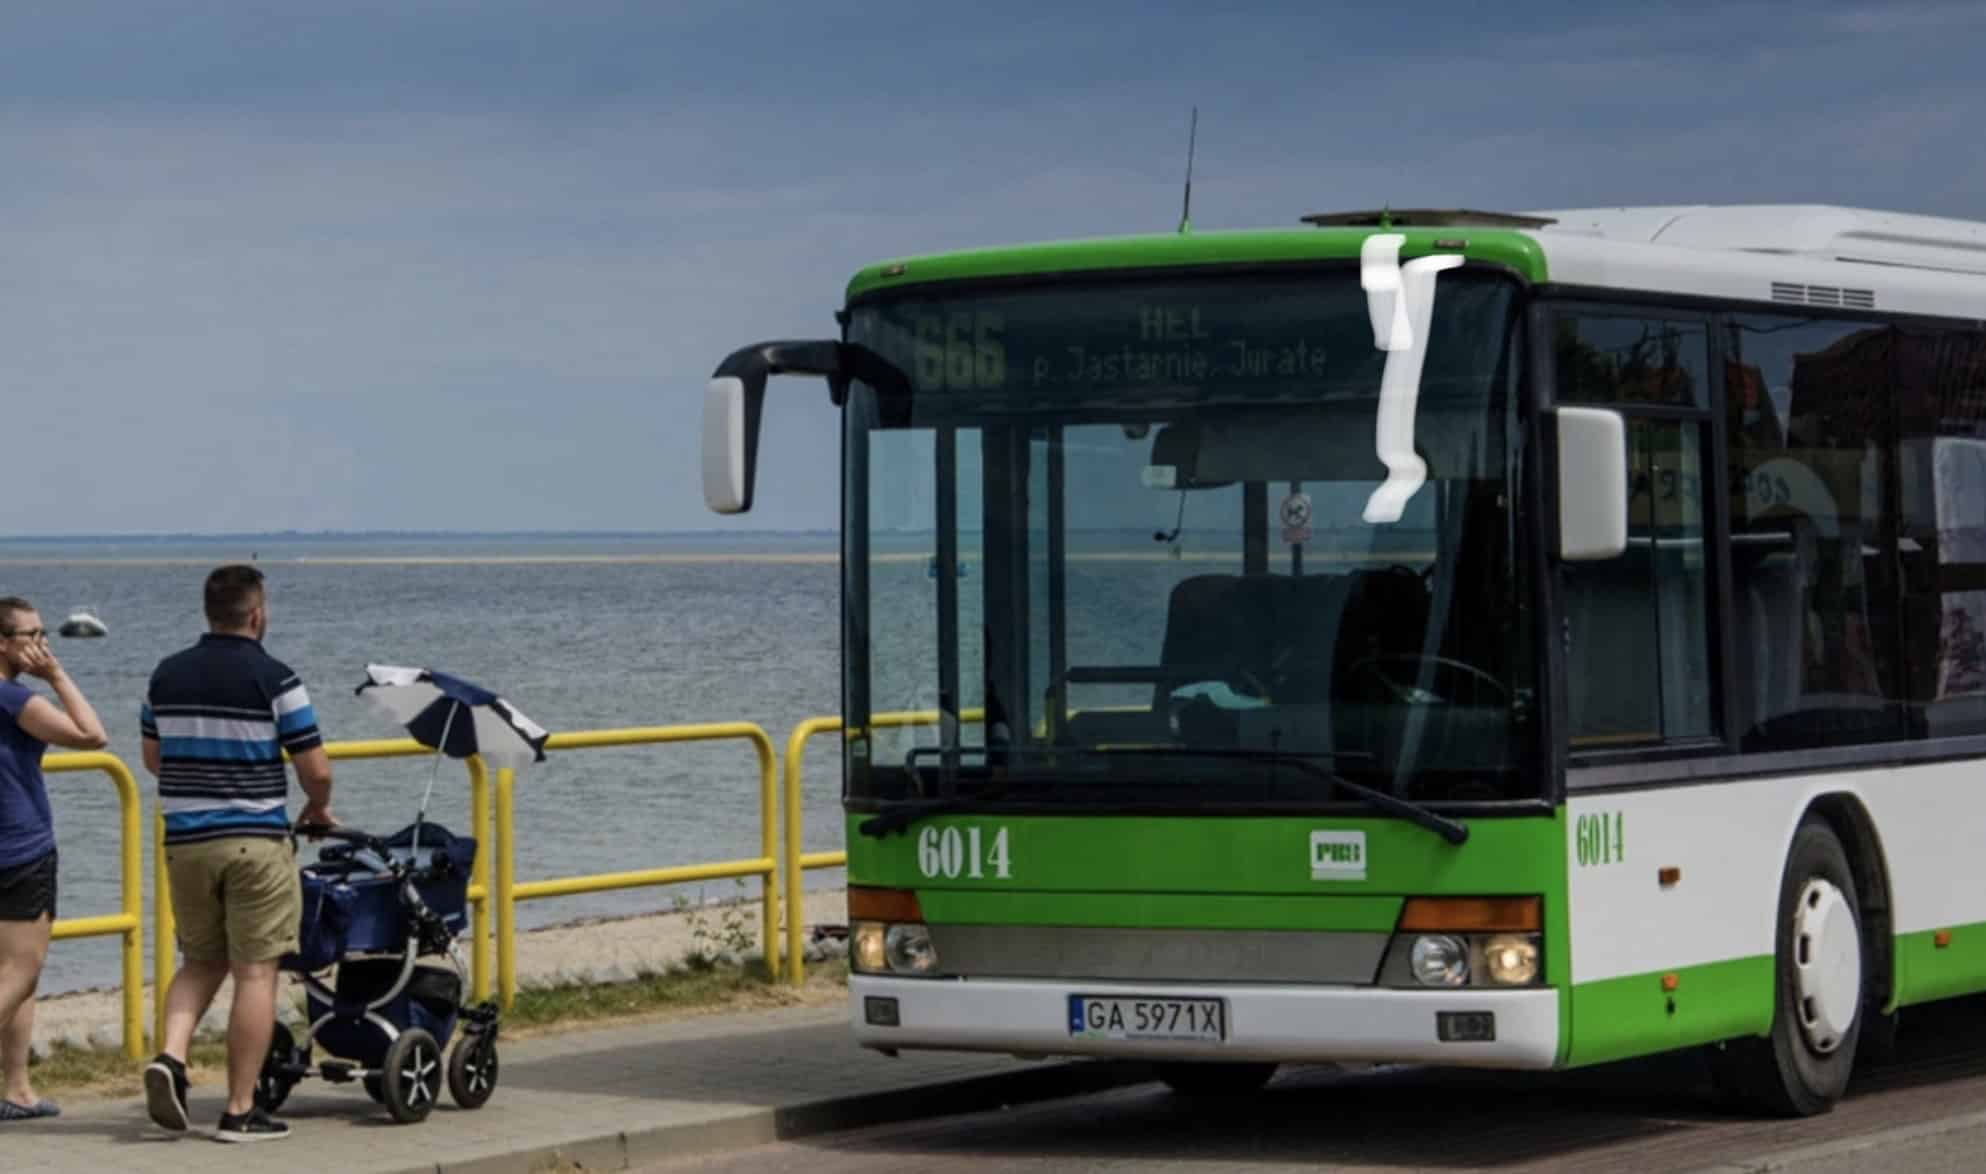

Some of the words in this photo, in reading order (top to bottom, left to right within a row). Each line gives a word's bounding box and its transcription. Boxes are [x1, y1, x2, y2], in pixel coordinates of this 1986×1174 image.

[1138, 303, 1209, 342] HEL
[912, 312, 1007, 391] 666
[918, 825, 1014, 879] 6014
[1576, 811, 1625, 868] 6014
[1087, 1000, 1125, 1031] GA
[1135, 1002, 1217, 1032] 5971X
